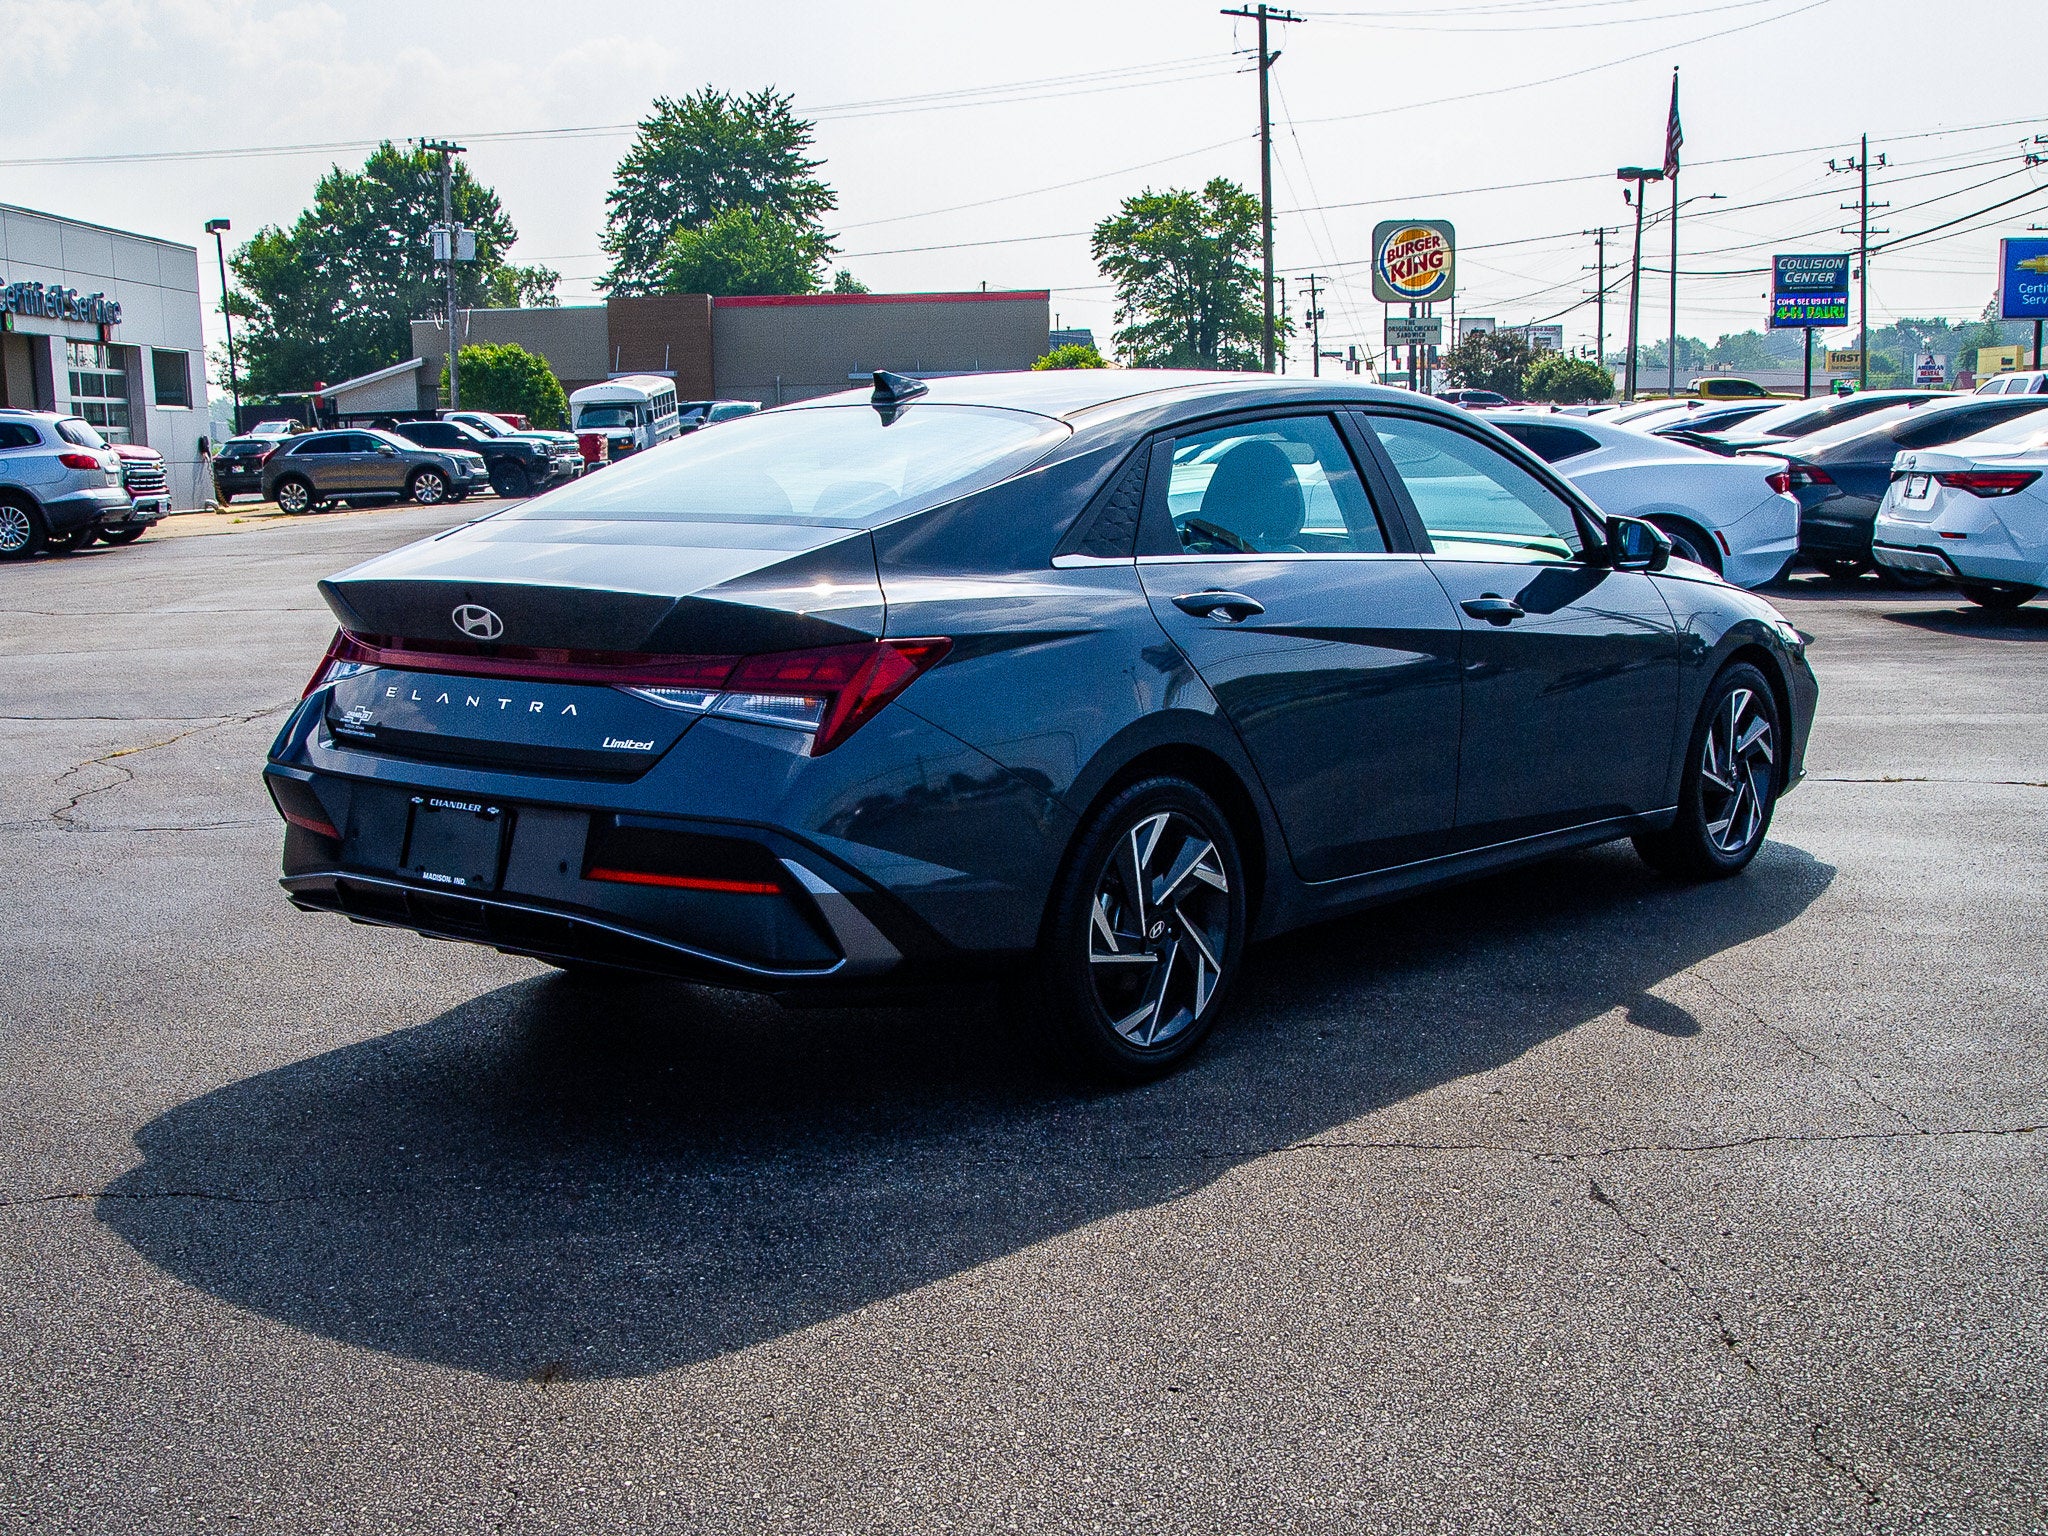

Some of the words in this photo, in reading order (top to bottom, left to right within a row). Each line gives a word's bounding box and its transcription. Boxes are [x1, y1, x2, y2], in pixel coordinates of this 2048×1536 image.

[1387, 236, 1440, 263] BURGER
[1391, 250, 1443, 282] KING
[1778, 258, 1845, 270] COLLISION
[1784, 271, 1836, 283] CENTER
[2018, 283, 2048, 293] Certi
[67, 288, 122, 325] Service
[1776, 298, 1796, 306] COME
[385, 686, 577, 716] ELANTRA
[602, 737, 654, 751] Limited
[430, 798, 481, 812] CHANDLER
